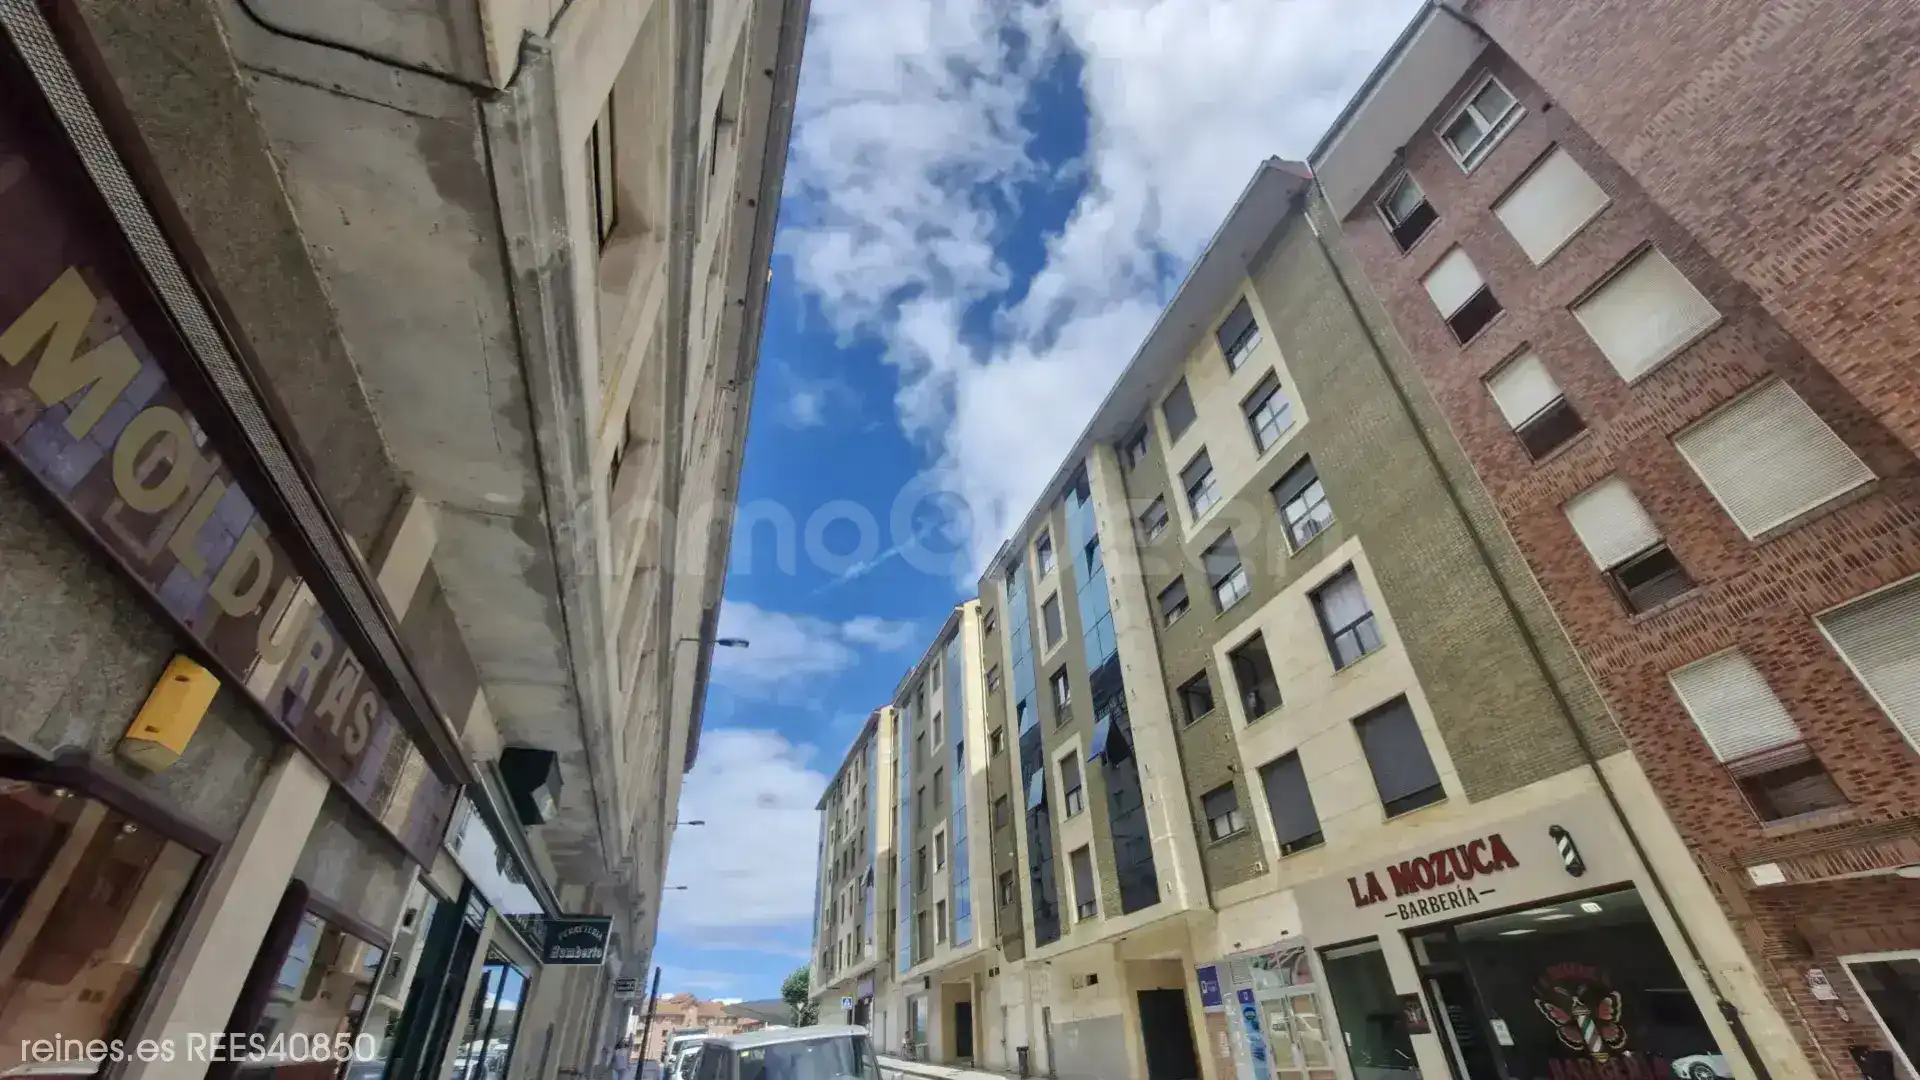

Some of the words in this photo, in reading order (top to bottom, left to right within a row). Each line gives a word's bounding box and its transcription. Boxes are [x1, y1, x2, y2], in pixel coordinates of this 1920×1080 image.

[0, 265, 378, 755] MOLDURAS
[1347, 871, 1388, 907] LA
[1387, 834, 1520, 897] MOZUCA
[1397, 884, 1480, 920] BARBERÍA
